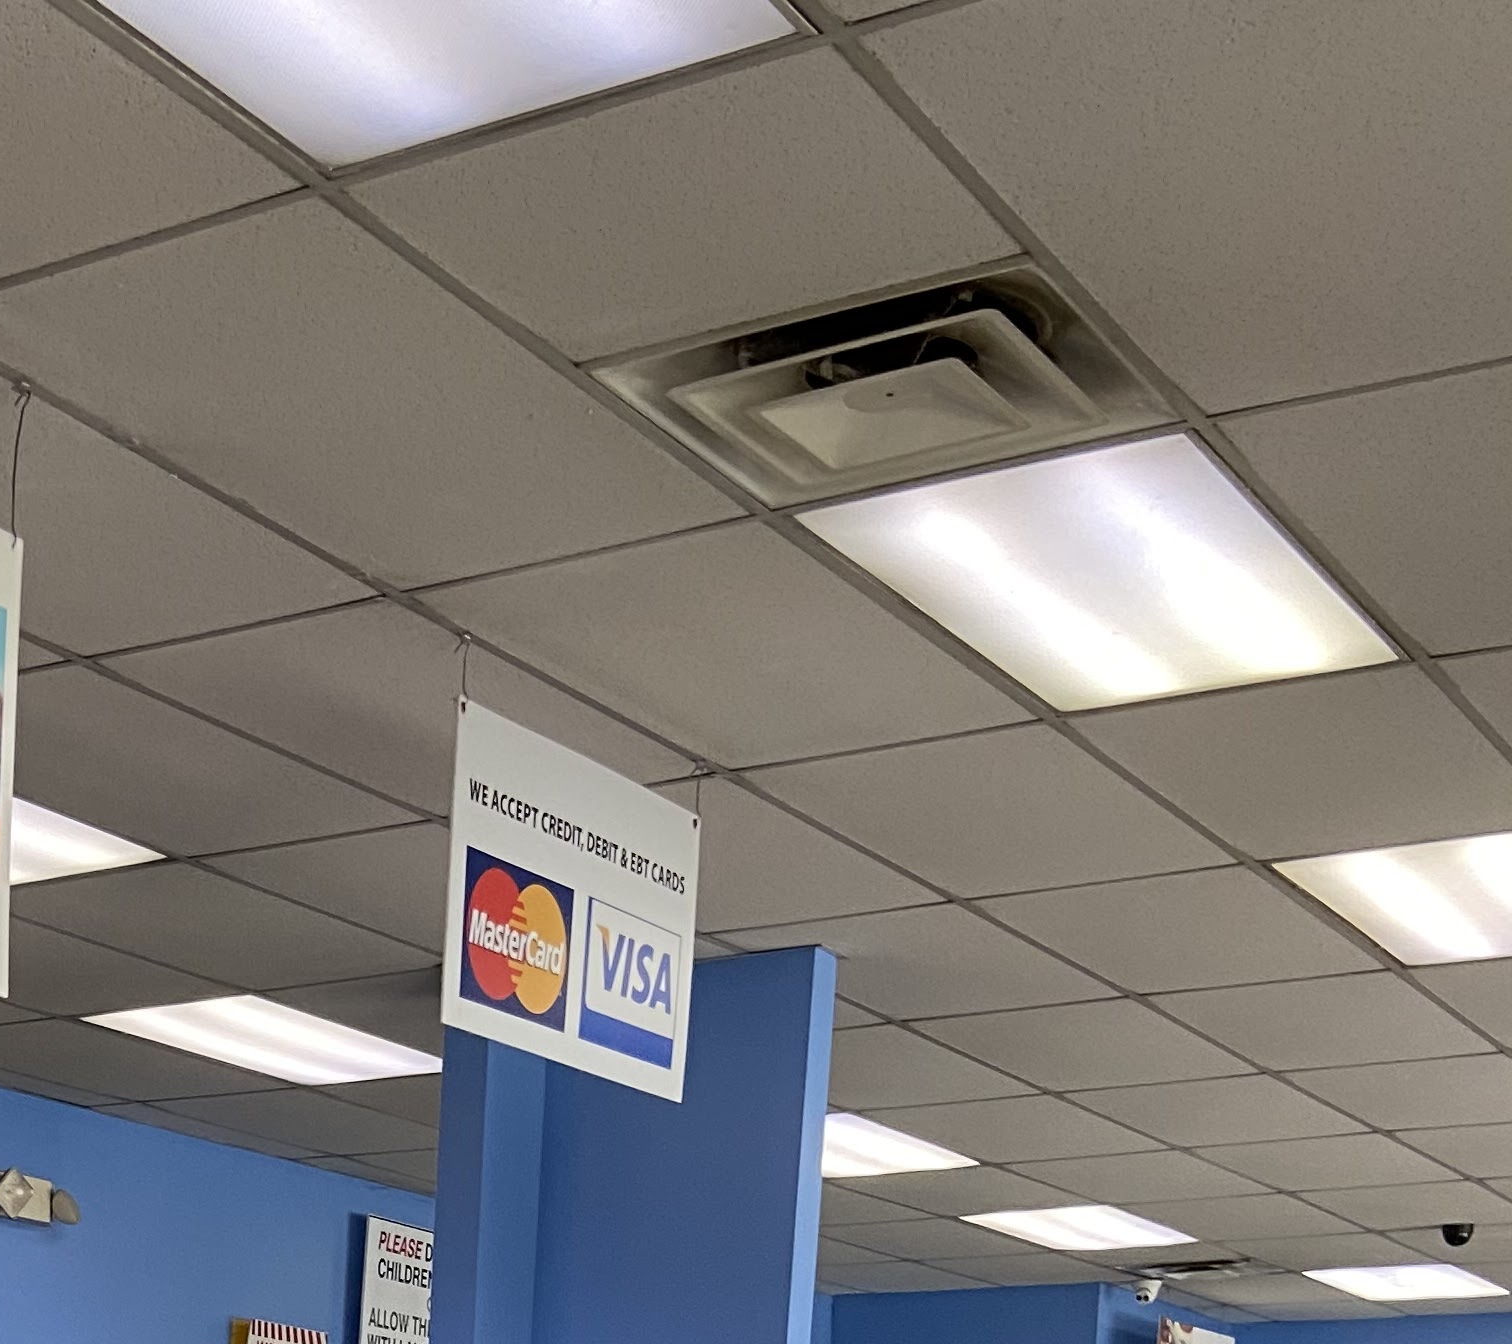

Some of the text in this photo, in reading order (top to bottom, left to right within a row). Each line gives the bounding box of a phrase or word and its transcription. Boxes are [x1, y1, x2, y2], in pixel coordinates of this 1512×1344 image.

[469, 778, 686, 895] WE ACCEPT CREDIT, DEBIT & EBT CARDS
[468, 907, 564, 977] MasterCard
[595, 922, 672, 1015] VISA
[378, 1230, 424, 1260] PLEASE
[368, 1307, 409, 1333] ALLOW
